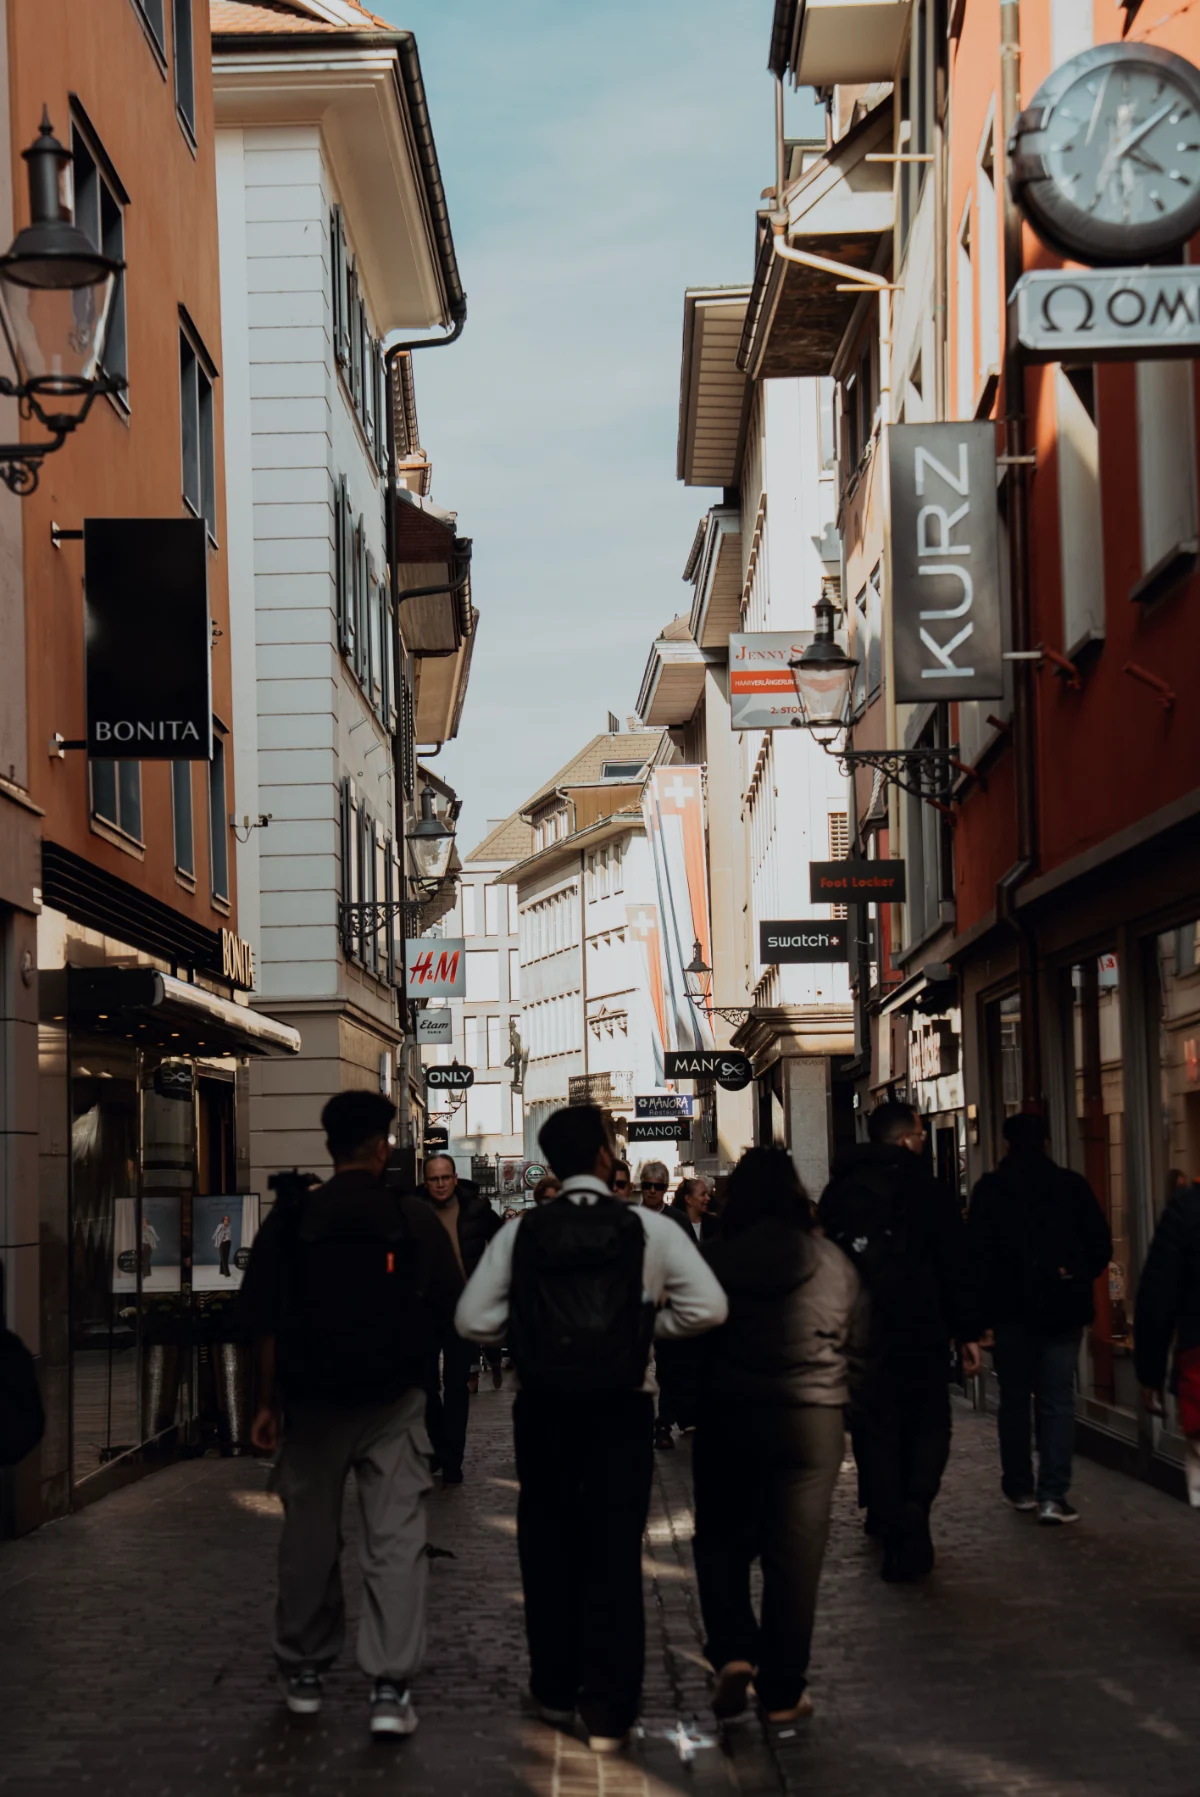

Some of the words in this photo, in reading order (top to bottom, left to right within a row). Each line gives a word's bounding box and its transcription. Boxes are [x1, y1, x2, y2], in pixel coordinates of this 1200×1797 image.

[1107, 288, 1200, 327] OM
[915, 443, 975, 679] KURZ
[735, 645, 787, 661] JENNY
[790, 644, 805, 660] S
[771, 706, 779, 714] 2.
[95, 720, 200, 741] BONITA
[820, 876, 847, 888] Foot
[852, 876, 895, 888] Locker
[767, 933, 829, 948] swatch
[222, 927, 254, 989] BONITA
[409, 949, 460, 985] H&M
[420, 1020, 448, 1030] Etam
[674, 1058, 721, 1072] MAN
[428, 1071, 470, 1083] ONLY
[649, 1097, 688, 1110] MANORA
[635, 1125, 682, 1136] MANOR
